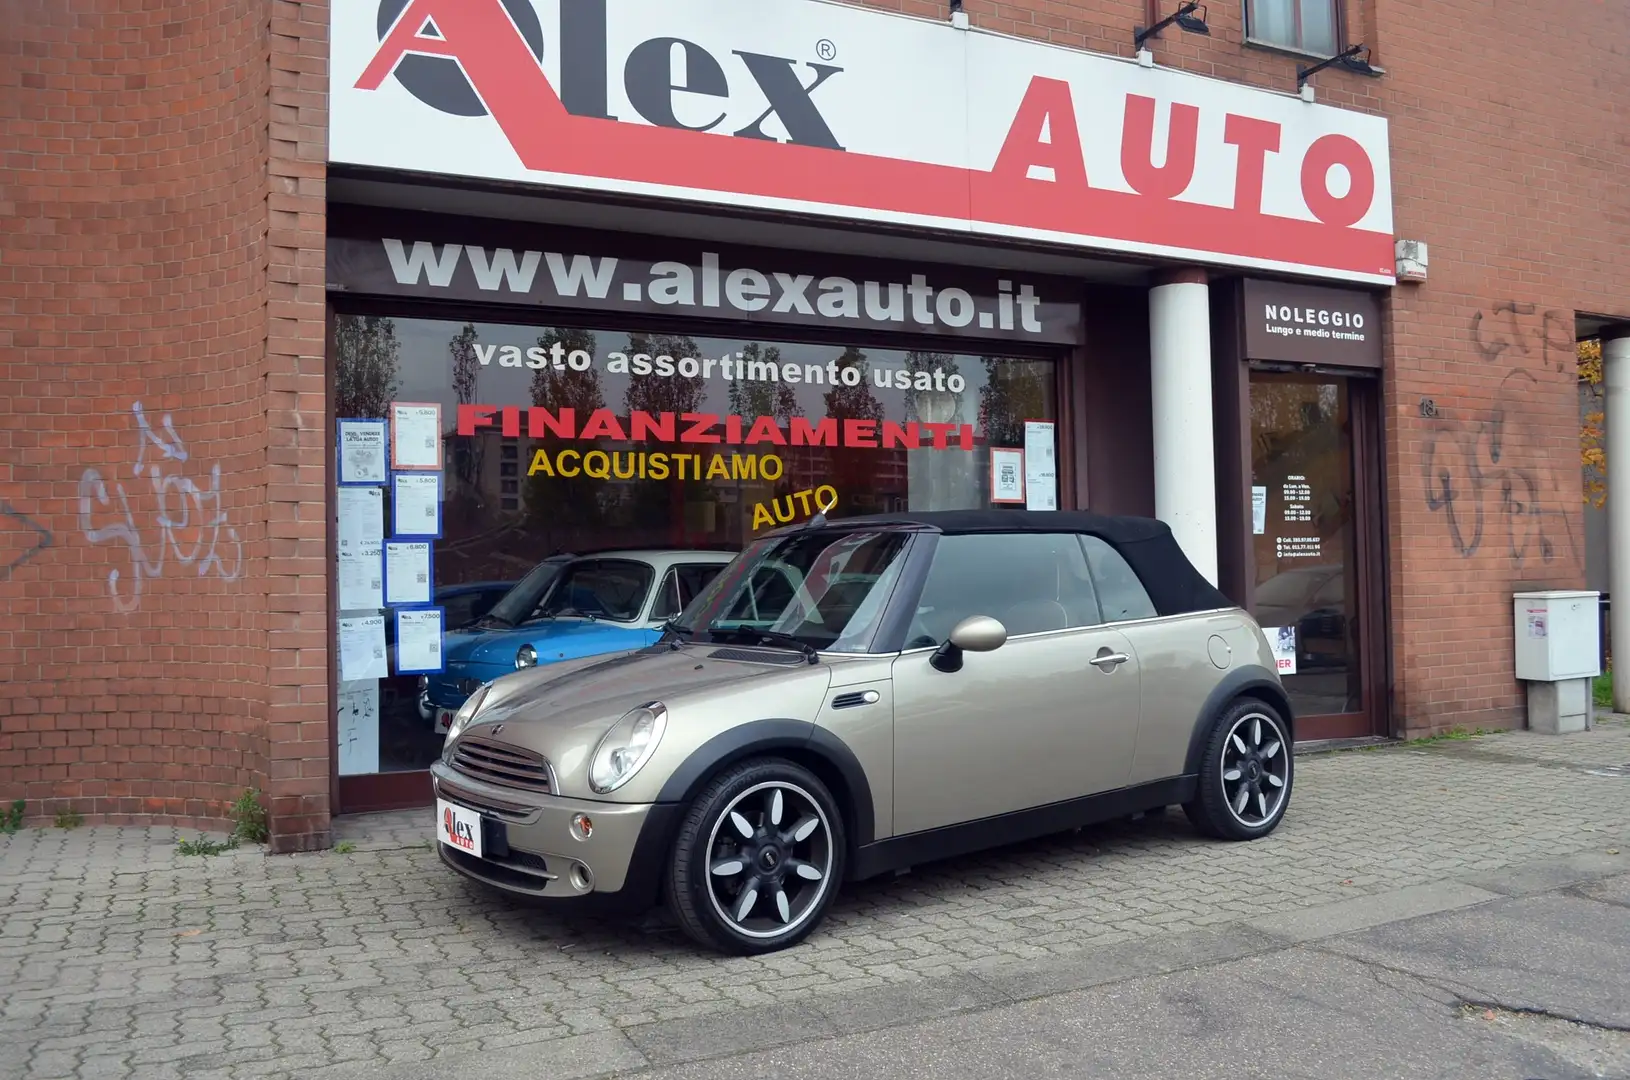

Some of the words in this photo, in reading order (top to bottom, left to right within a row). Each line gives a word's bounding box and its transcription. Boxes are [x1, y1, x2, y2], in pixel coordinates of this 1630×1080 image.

[353, 0, 847, 153] Alex
[991, 75, 1375, 228] AUTO
[382, 238, 1042, 333] www.alexauto.it
[1265, 304, 1364, 329] NOLEGGIO
[1265, 323, 1294, 336] Lungo
[1295, 327, 1302, 336] e
[1303, 328, 1331, 339] medio
[1331, 330, 1365, 342] termine
[473, 341, 591, 371] vasto
[607, 352, 861, 386] assortimento
[873, 366, 966, 393] usato
[457, 404, 974, 451] FINANZIAMENTI
[527, 449, 783, 481] ACQUISTIAMO
[752, 484, 838, 530] AUTO
[444, 807, 474, 841] Alex
